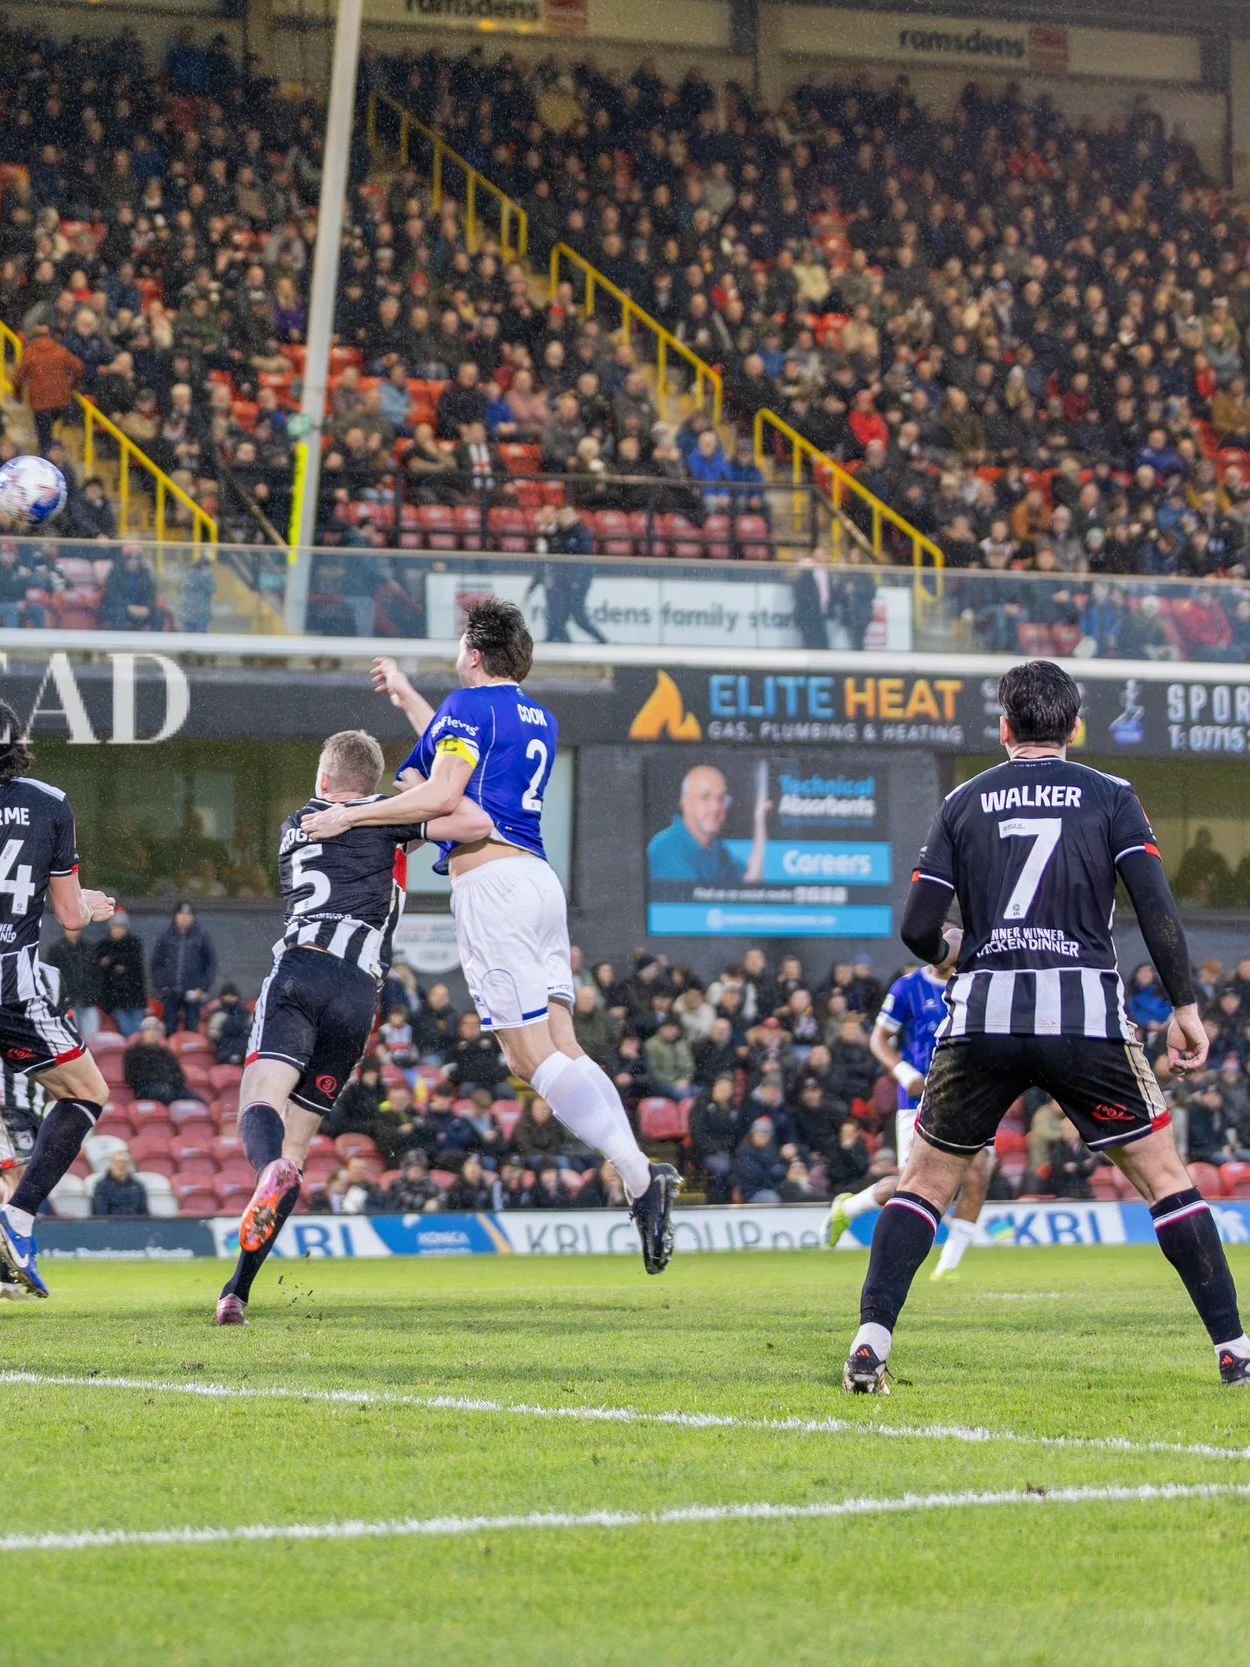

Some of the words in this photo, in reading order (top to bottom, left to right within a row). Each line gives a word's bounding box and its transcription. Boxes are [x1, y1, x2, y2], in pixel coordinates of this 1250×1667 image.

[661, 602, 738, 633] family
[708, 674, 835, 719] ELITE
[843, 677, 964, 722] HEAT
[759, 722, 858, 743] PLUMBING
[863, 724, 876, 742] &
[882, 724, 964, 745] HEATING
[521, 738, 548, 812] 2
[778, 773, 876, 797] Technical
[778, 793, 877, 818] Absorbents
[980, 785, 1082, 813] WALKER
[782, 849, 872, 876] Careers
[998, 817, 1062, 920] 7
[291, 843, 331, 916] 5
[1023, 927, 1065, 941] WINNER
[1029, 939, 1080, 958] DINNER
